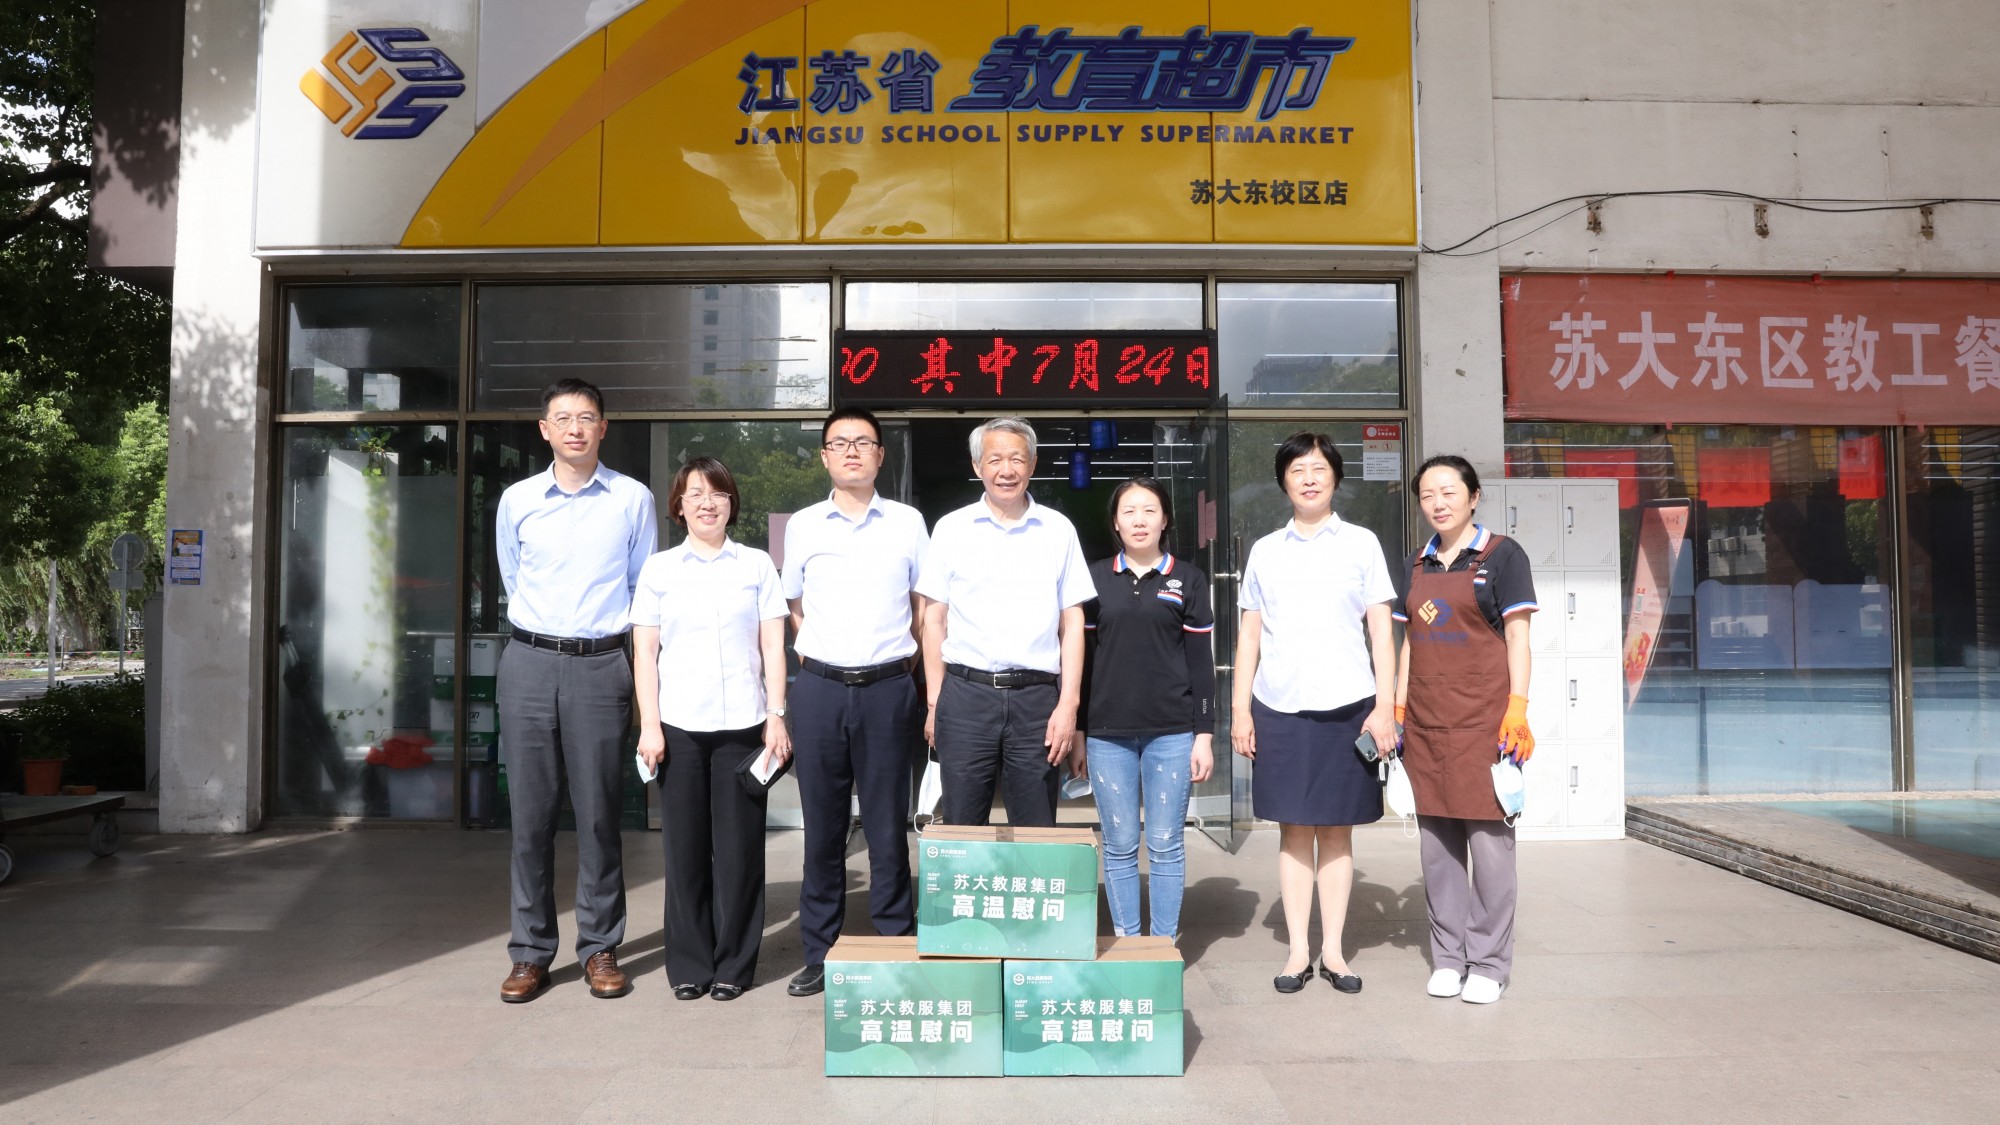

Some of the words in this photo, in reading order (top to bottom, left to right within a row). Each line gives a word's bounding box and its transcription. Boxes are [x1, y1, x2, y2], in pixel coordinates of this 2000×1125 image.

[735, 126, 864, 145] JIANGSU
[881, 125, 1000, 143] SCHOOL
[1016, 125, 1124, 143] SUPPLY
[1140, 125, 1354, 145] SUPERMARKET
[1189, 179, 1348, 206] 苏大东校区店
[1548, 311, 2000, 394] 苏大东区教工餐
[953, 874, 1065, 894] 苏大教服集团
[952, 894, 1065, 921] 高温慰问
[860, 999, 972, 1016] 苏大教服集团
[1041, 999, 1153, 1016] 苏大教服集团
[860, 1019, 973, 1043] 高温慰问
[1041, 1019, 1154, 1043] 高温慰问
